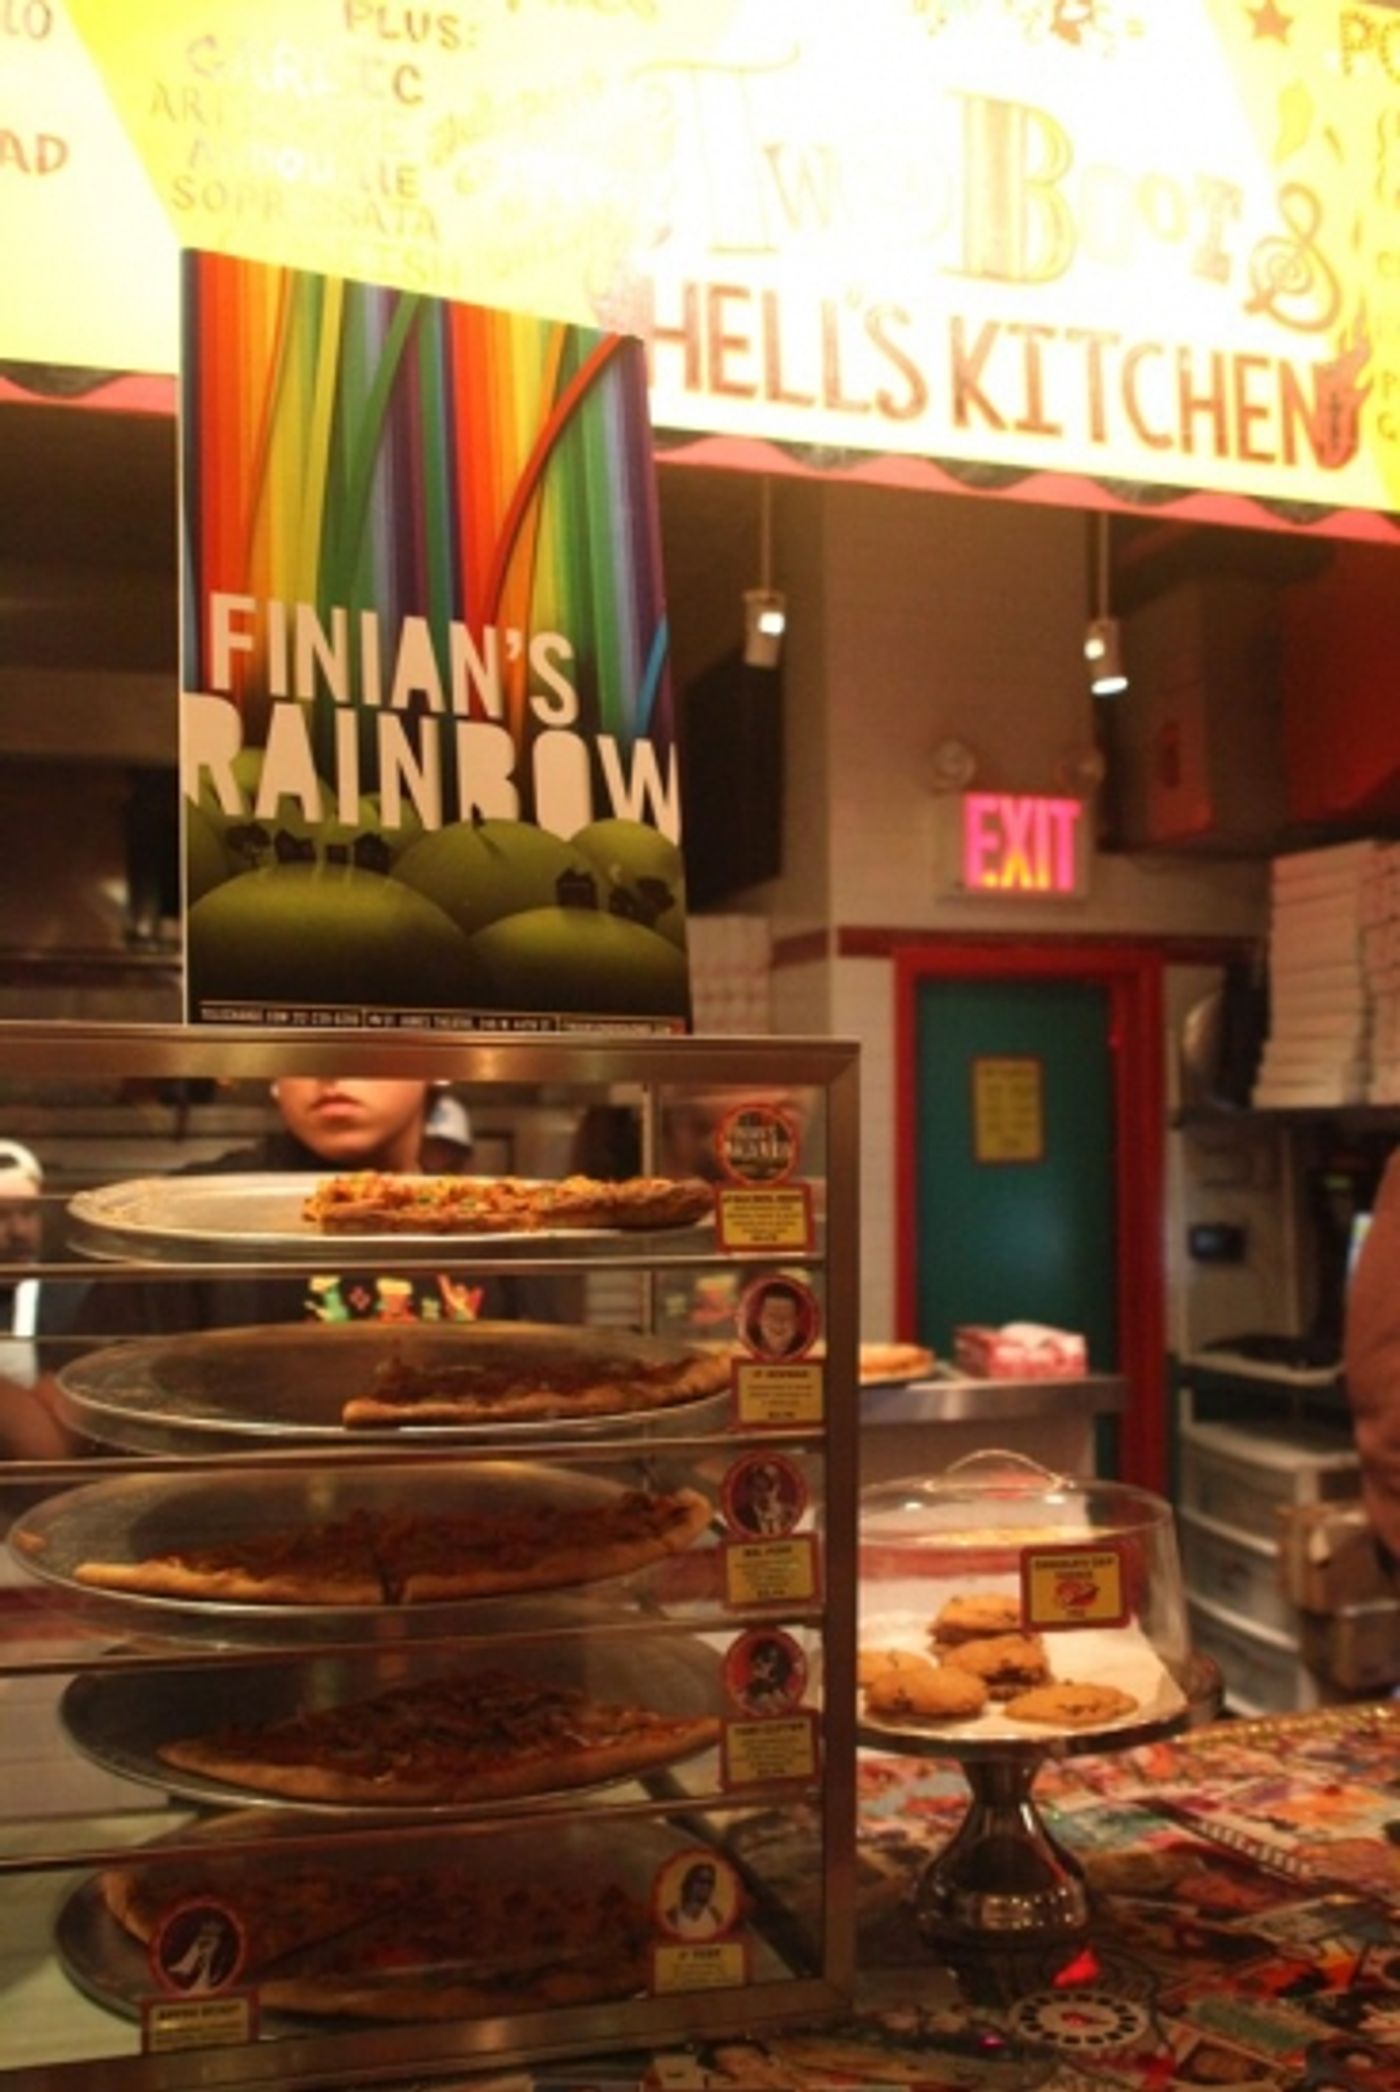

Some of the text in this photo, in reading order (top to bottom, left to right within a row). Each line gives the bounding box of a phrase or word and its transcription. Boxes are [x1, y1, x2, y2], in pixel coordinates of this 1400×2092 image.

[947, 313, 1358, 471] KITCHEN
[210, 592, 579, 728] FINIAN'S
[181, 691, 683, 848] RAINBOW
[964, 792, 1082, 892] EXIT
